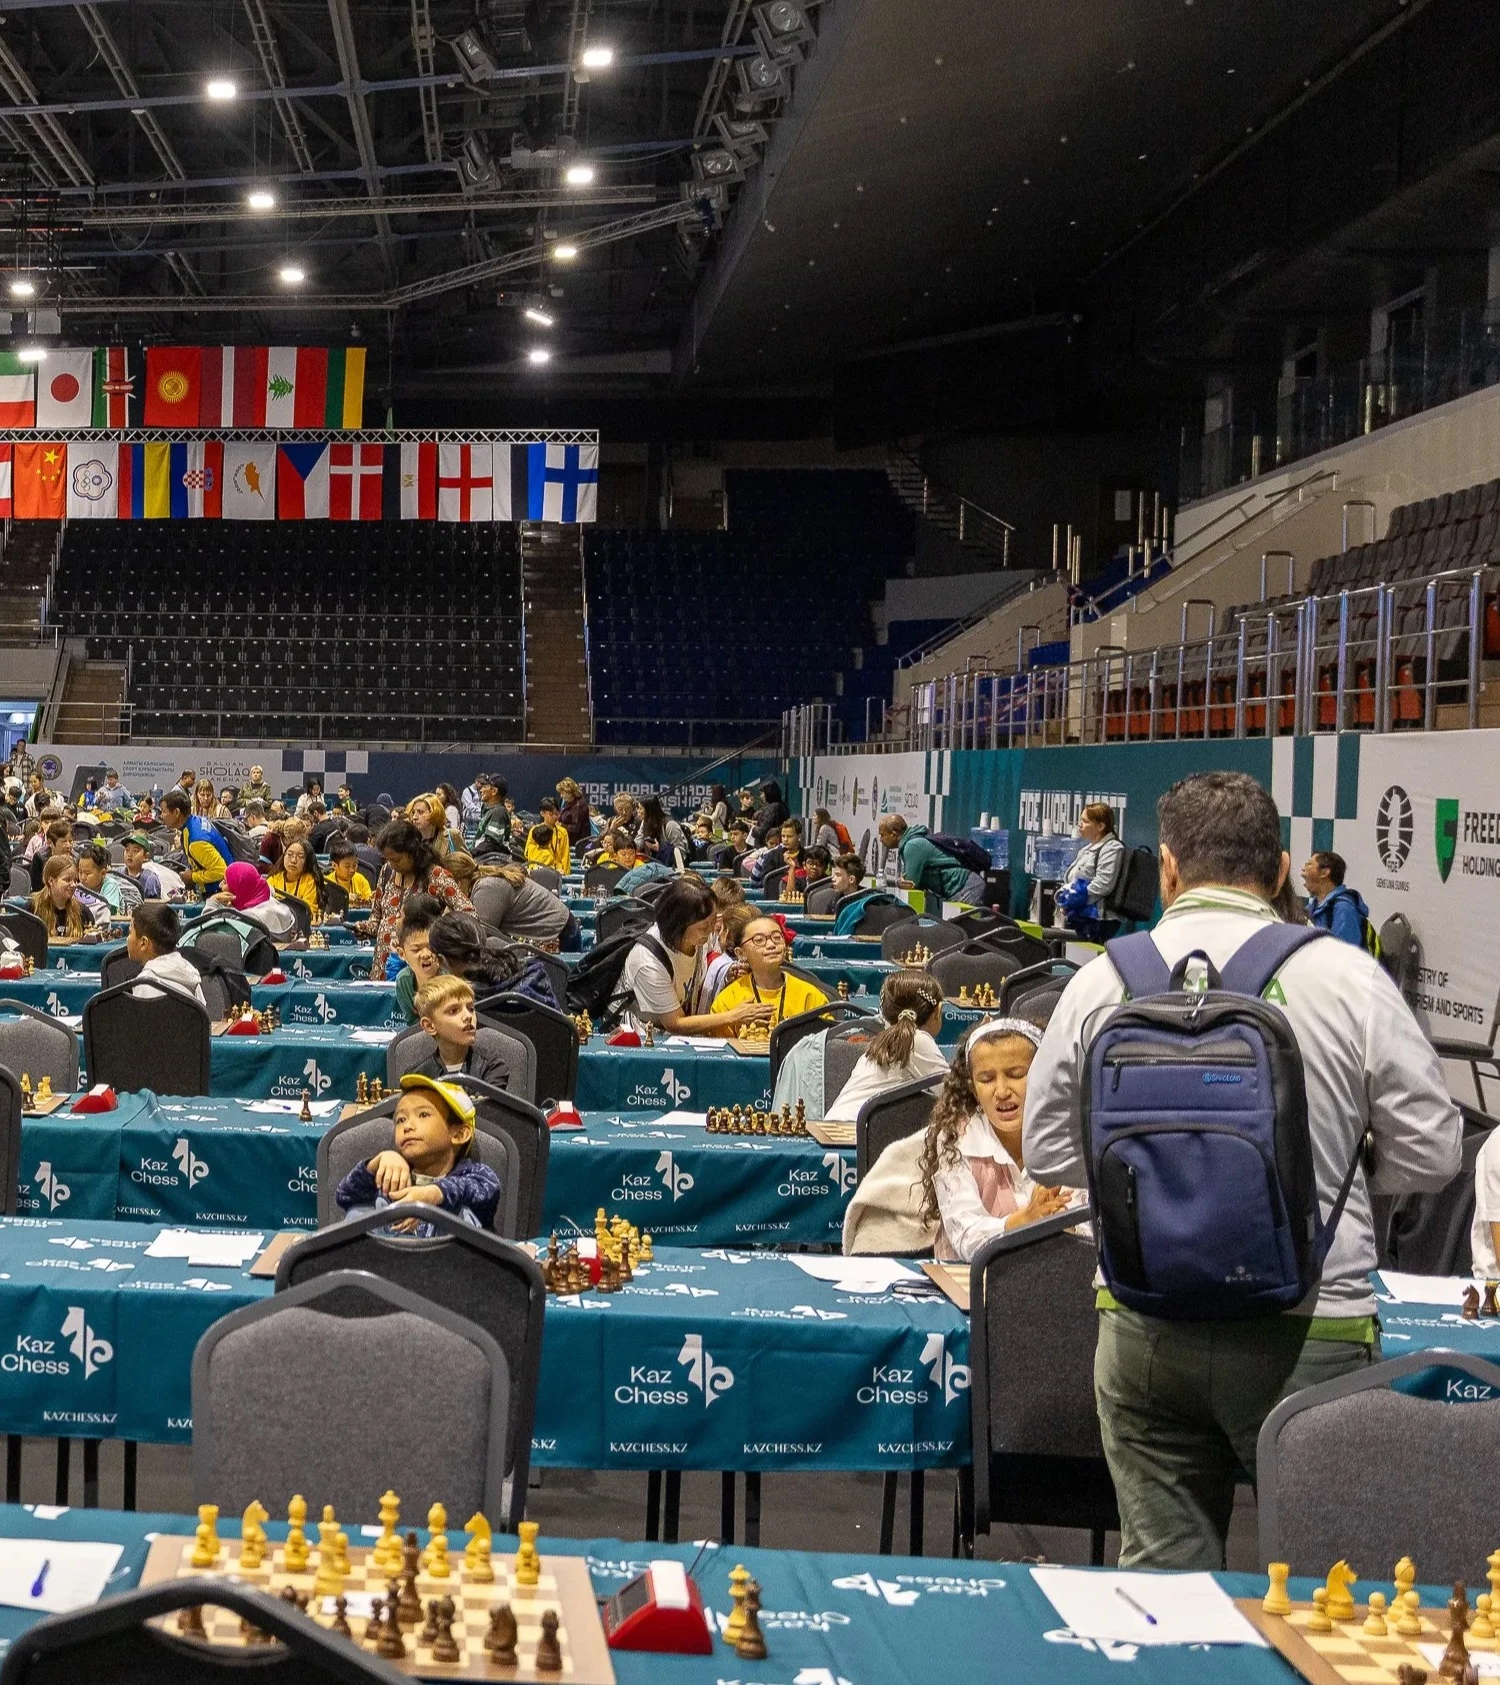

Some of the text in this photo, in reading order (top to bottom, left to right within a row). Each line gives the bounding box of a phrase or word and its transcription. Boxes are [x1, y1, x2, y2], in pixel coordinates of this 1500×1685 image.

[579, 783, 714, 797] FIDE WORLD CADE
[1462, 855, 1500, 878] HOLDING
[1418, 967, 1448, 988] STRY OF
[295, 1005, 311, 1013] Kaz
[1435, 998, 1451, 1017] AND
[1452, 1002, 1484, 1025] SPORTS
[945, 1010, 979, 1021] Chess
[279, 1076, 300, 1085] Kaz
[636, 1085, 657, 1094] Kaz
[627, 1095, 666, 1105] Chess
[141, 1158, 167, 1171] Kaz
[131, 1171, 178, 1185] Chess
[298, 1166, 317, 1179] Ka
[790, 1169, 817, 1181] Kaz
[623, 1174, 650, 1186] Kaz
[288, 1180, 317, 1193] Che
[778, 1184, 828, 1196] Chess
[612, 1188, 662, 1200] Chess
[16, 1197, 40, 1209] ess
[117, 1206, 161, 1217] AZCHESS.KZ
[196, 1213, 247, 1222] KAZCHESS.KZ
[283, 1216, 318, 1226] KAZCHES
[736, 1222, 789, 1231] KAZCHESS.KZ
[552, 1228, 594, 1237] KAZCHESS
[644, 1225, 697, 1233] KAZCHESS.KZ
[17, 1335, 54, 1353] Kaz
[1, 1354, 69, 1374] Chess
[631, 1367, 671, 1383] Kaz
[873, 1366, 912, 1383] Kaz
[615, 1386, 688, 1404] Chess
[857, 1386, 928, 1404] Chess
[1446, 1379, 1491, 1400] Kaz
[44, 1411, 117, 1423] KAZCHESS.KZ
[611, 1442, 687, 1452] KAZCHESS.KZ
[744, 1443, 821, 1453] KAZCHESS.KZ
[878, 1442, 952, 1453] KAZCHESS.KZ
